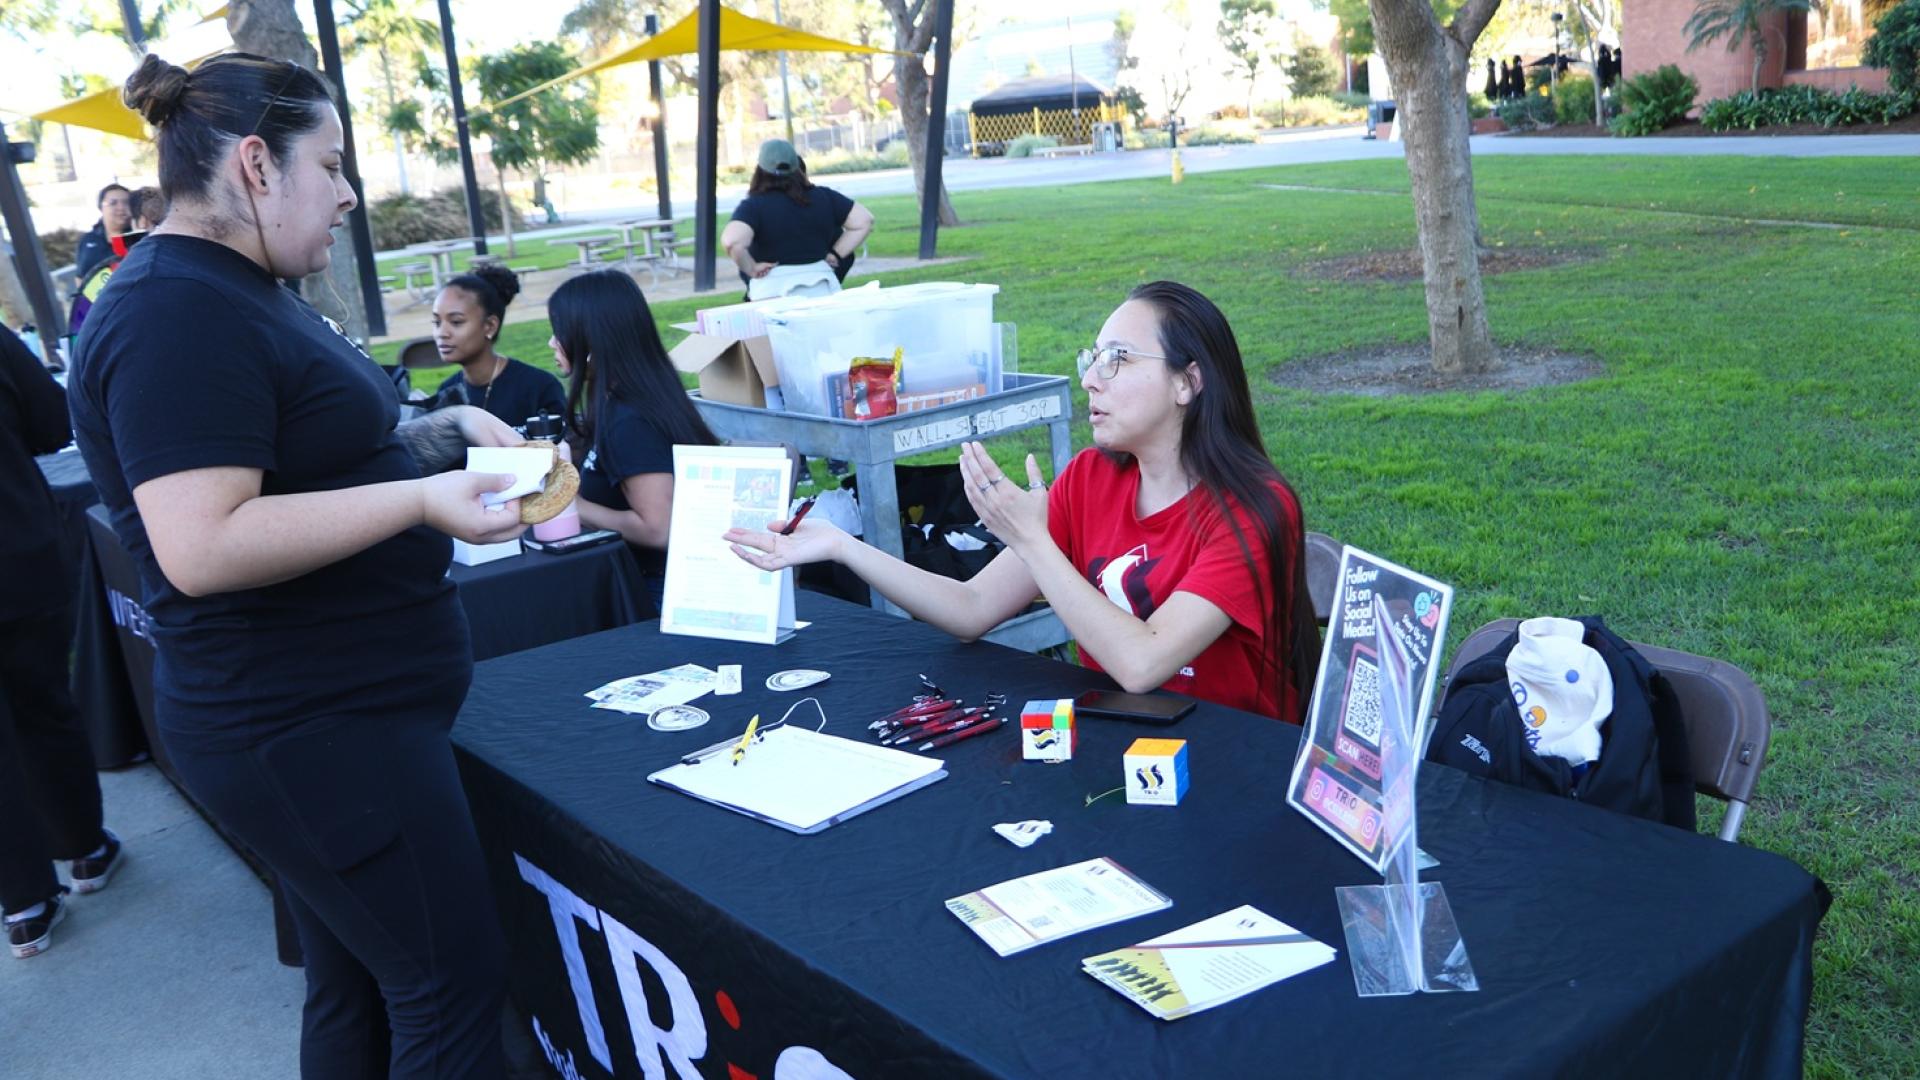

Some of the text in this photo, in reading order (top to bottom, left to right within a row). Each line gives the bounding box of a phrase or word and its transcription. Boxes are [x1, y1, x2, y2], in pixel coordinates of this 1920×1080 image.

[1017, 400, 1048, 422] 309
[1346, 566, 1378, 585] Follow
[1345, 586, 1371, 602] Us on
[1344, 600, 1372, 620] Social
[1343, 618, 1376, 639] Media!
[1338, 737, 1359, 760] SCAN
